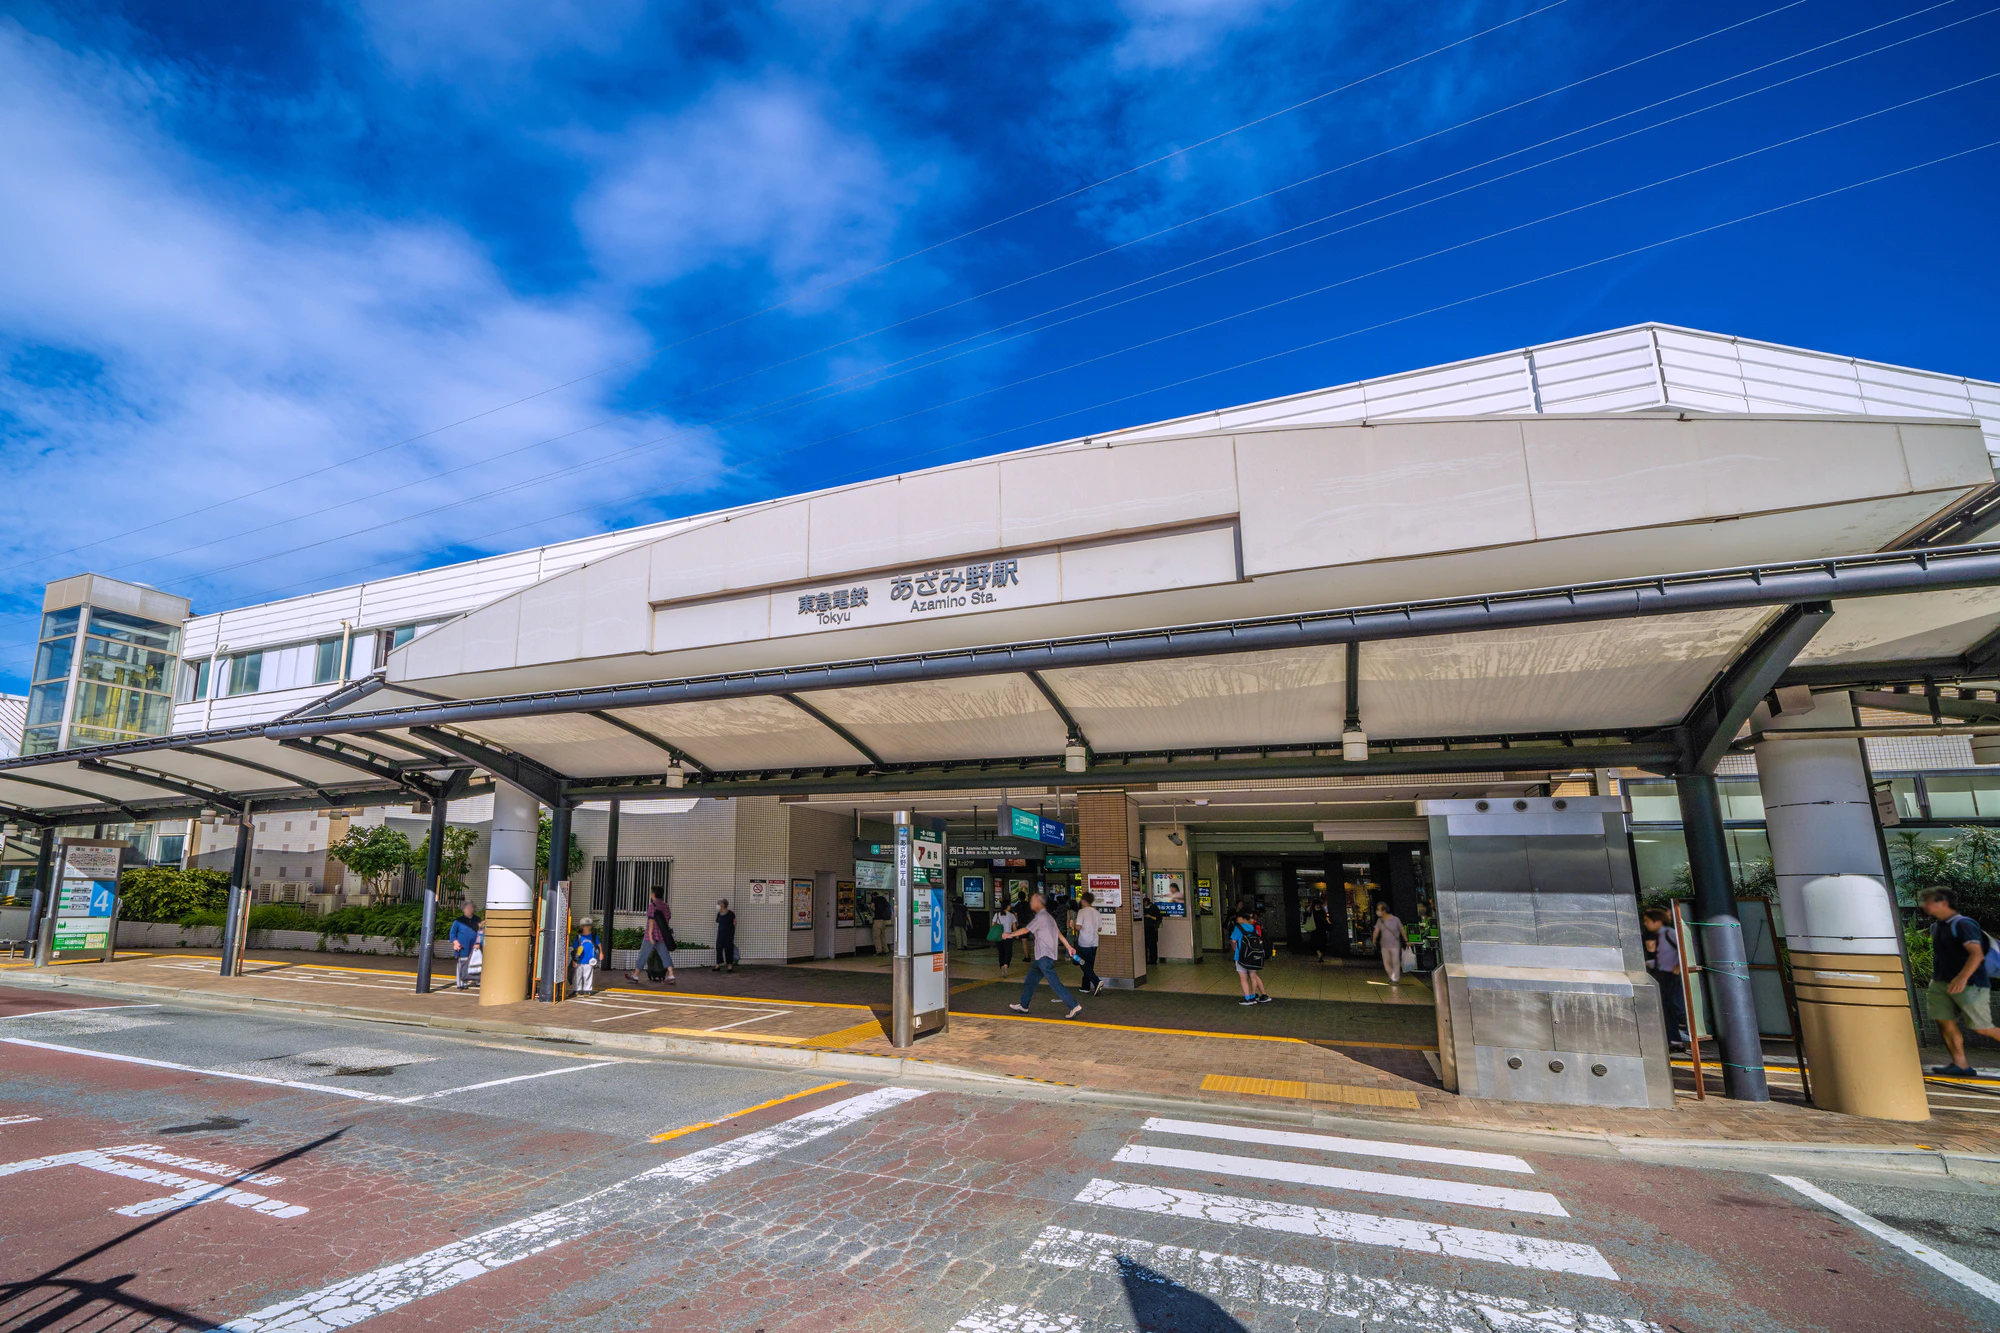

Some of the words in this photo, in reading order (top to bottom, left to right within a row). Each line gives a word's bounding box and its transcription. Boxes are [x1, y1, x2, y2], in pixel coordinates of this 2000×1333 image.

[797, 586, 868, 615] 東急電鉄
[890, 558, 1019, 602] あざみ野駅
[816, 611, 851, 625] Tokyu
[910, 594, 967, 613] Azamino
[970, 591, 998, 606] Sta.
[949, 846, 965, 855] 西口
[94, 890, 109, 912] 4
[933, 905, 942, 944] 3
